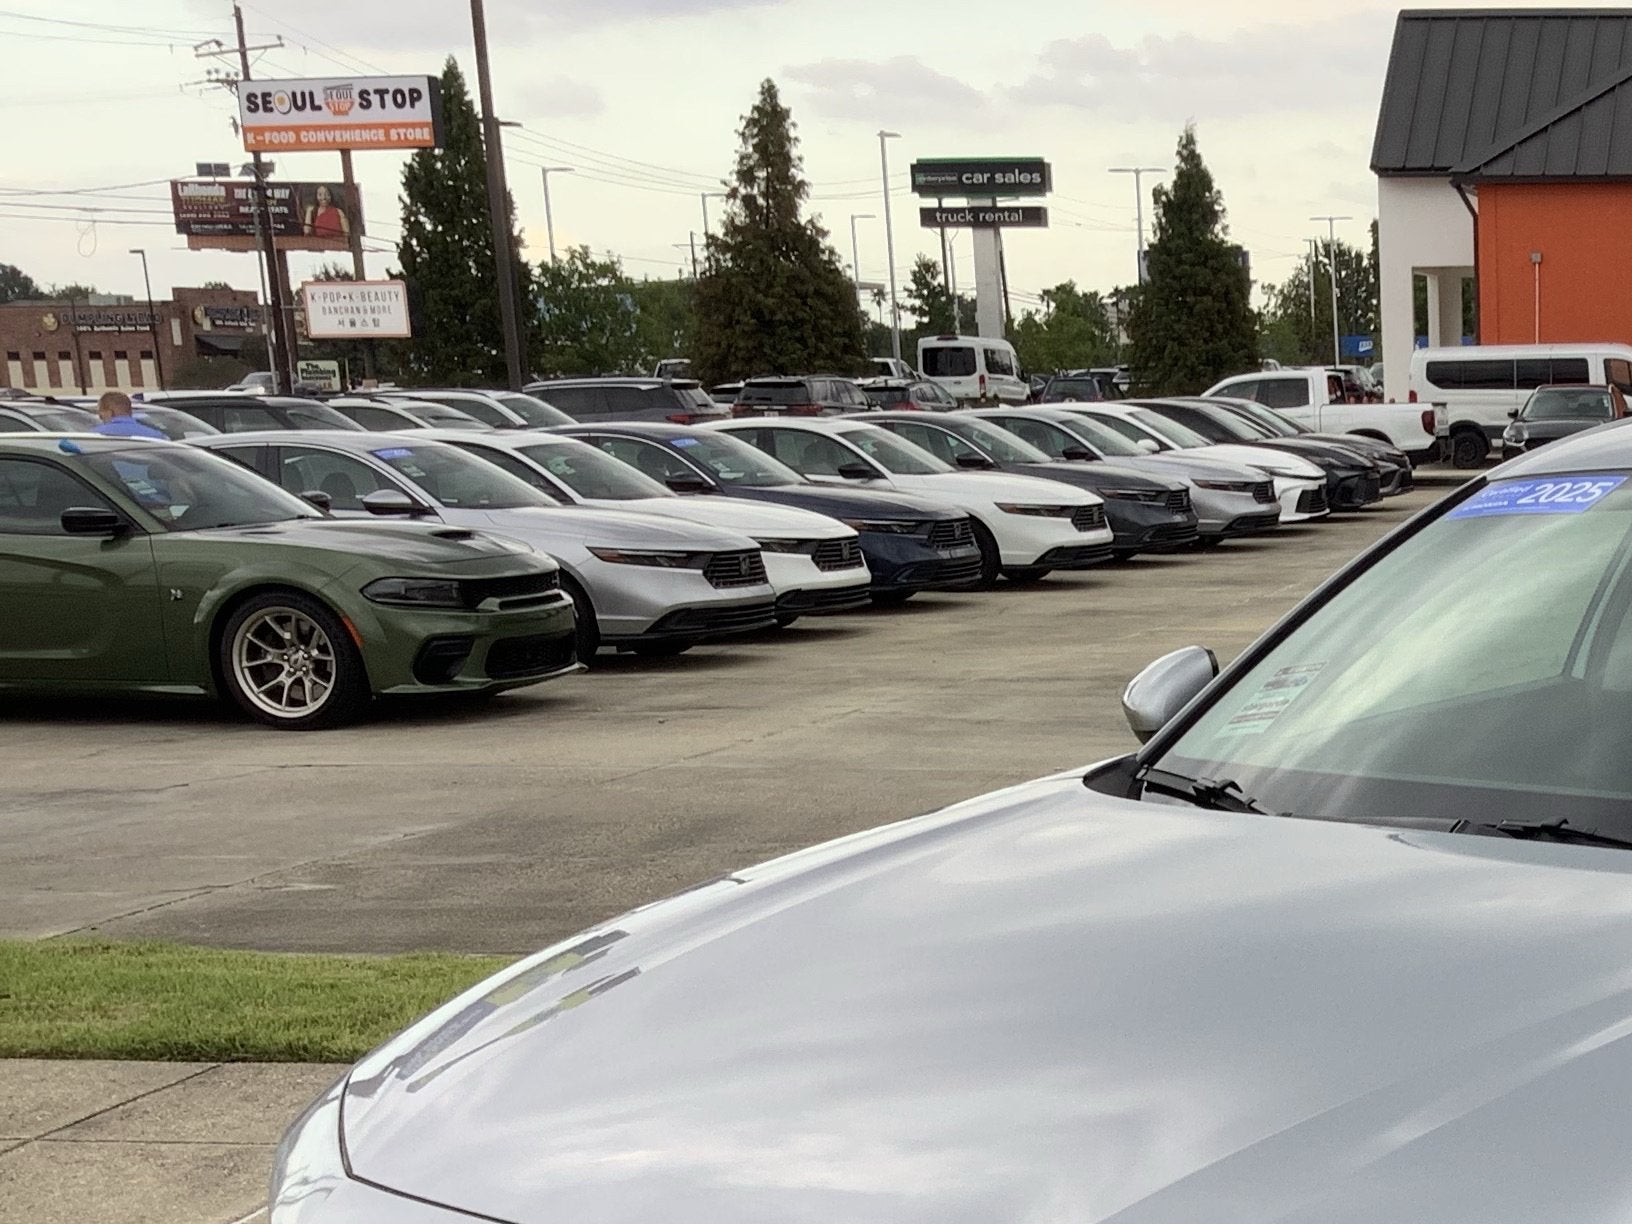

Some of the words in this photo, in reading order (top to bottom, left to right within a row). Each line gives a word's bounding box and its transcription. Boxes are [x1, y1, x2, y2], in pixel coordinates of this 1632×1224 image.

[245, 90, 323, 114] SEOUL
[358, 87, 422, 110] STOP
[247, 131, 296, 144] K-FOOD
[301, 129, 386, 143] CONVENIENCE
[390, 127, 430, 141] STORE
[962, 172, 991, 184] car
[994, 168, 1042, 184] sales
[273, 188, 290, 200] WAY
[935, 209, 974, 222] truck
[979, 209, 1023, 222] rental
[61, 312, 123, 325] DUMPLING
[1516, 481, 1614, 504] 2025
